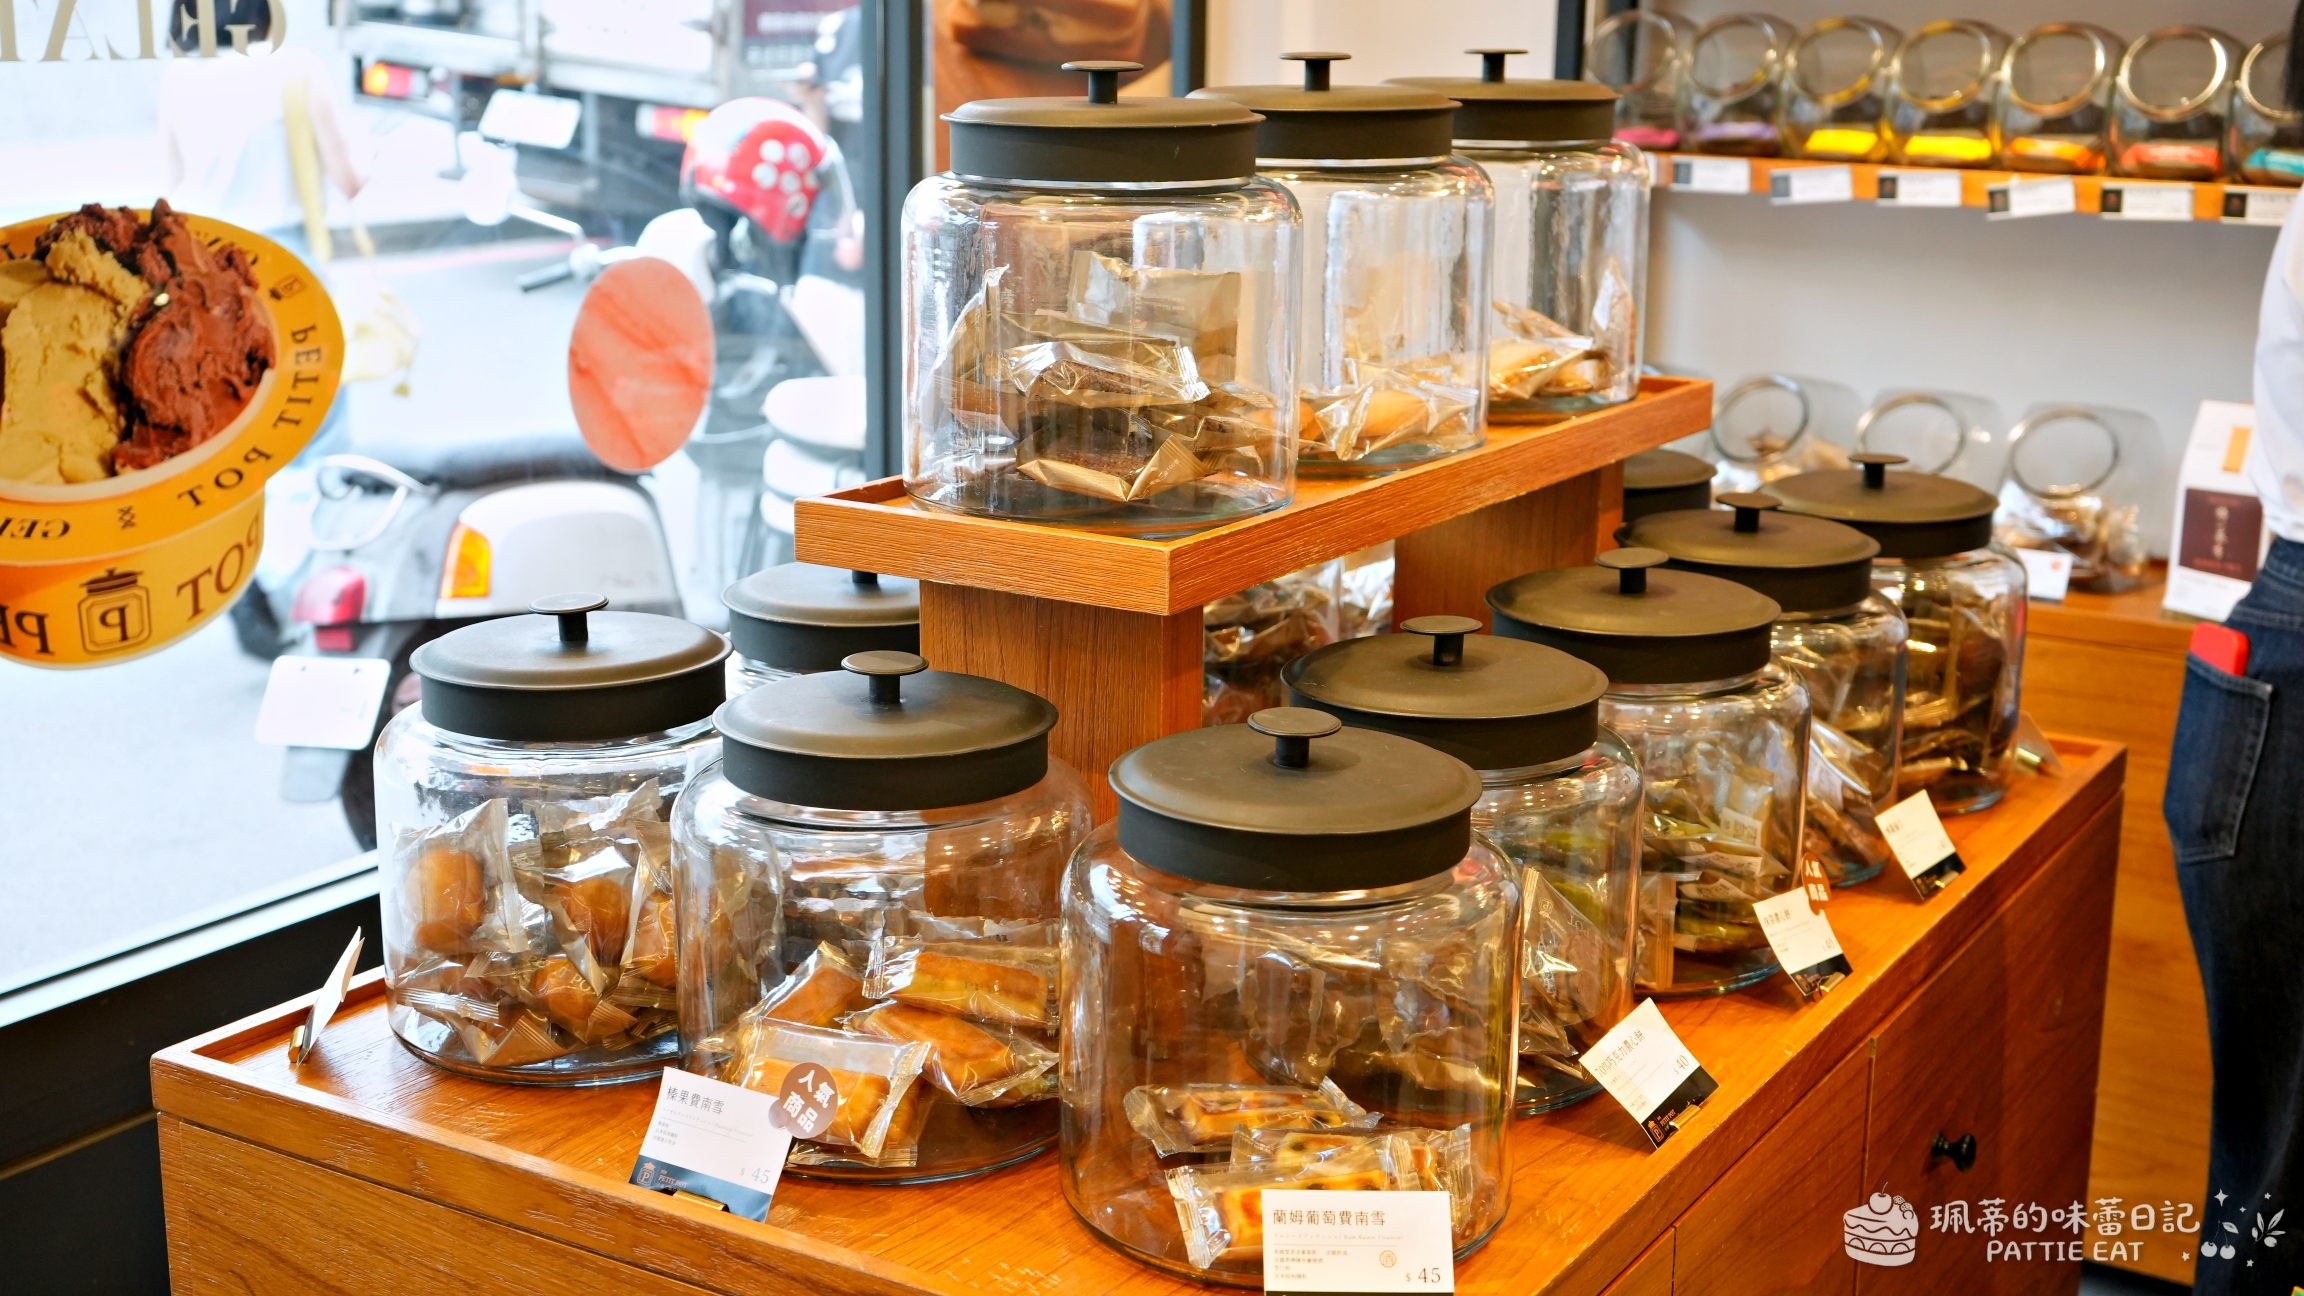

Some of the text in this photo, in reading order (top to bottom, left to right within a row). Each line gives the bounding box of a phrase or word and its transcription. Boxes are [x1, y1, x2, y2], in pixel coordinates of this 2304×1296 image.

[1675, 1054, 1689, 1070] 40
[798, 1069, 836, 1109] 人氣
[666, 1086, 725, 1114] 榛果費南雪
[782, 1091, 818, 1133] 商品
[751, 1167, 770, 1185] 45
[1273, 1209, 1386, 1226] 蘭姆葡萄費南雪
[1405, 1267, 1442, 1284] $ 45
